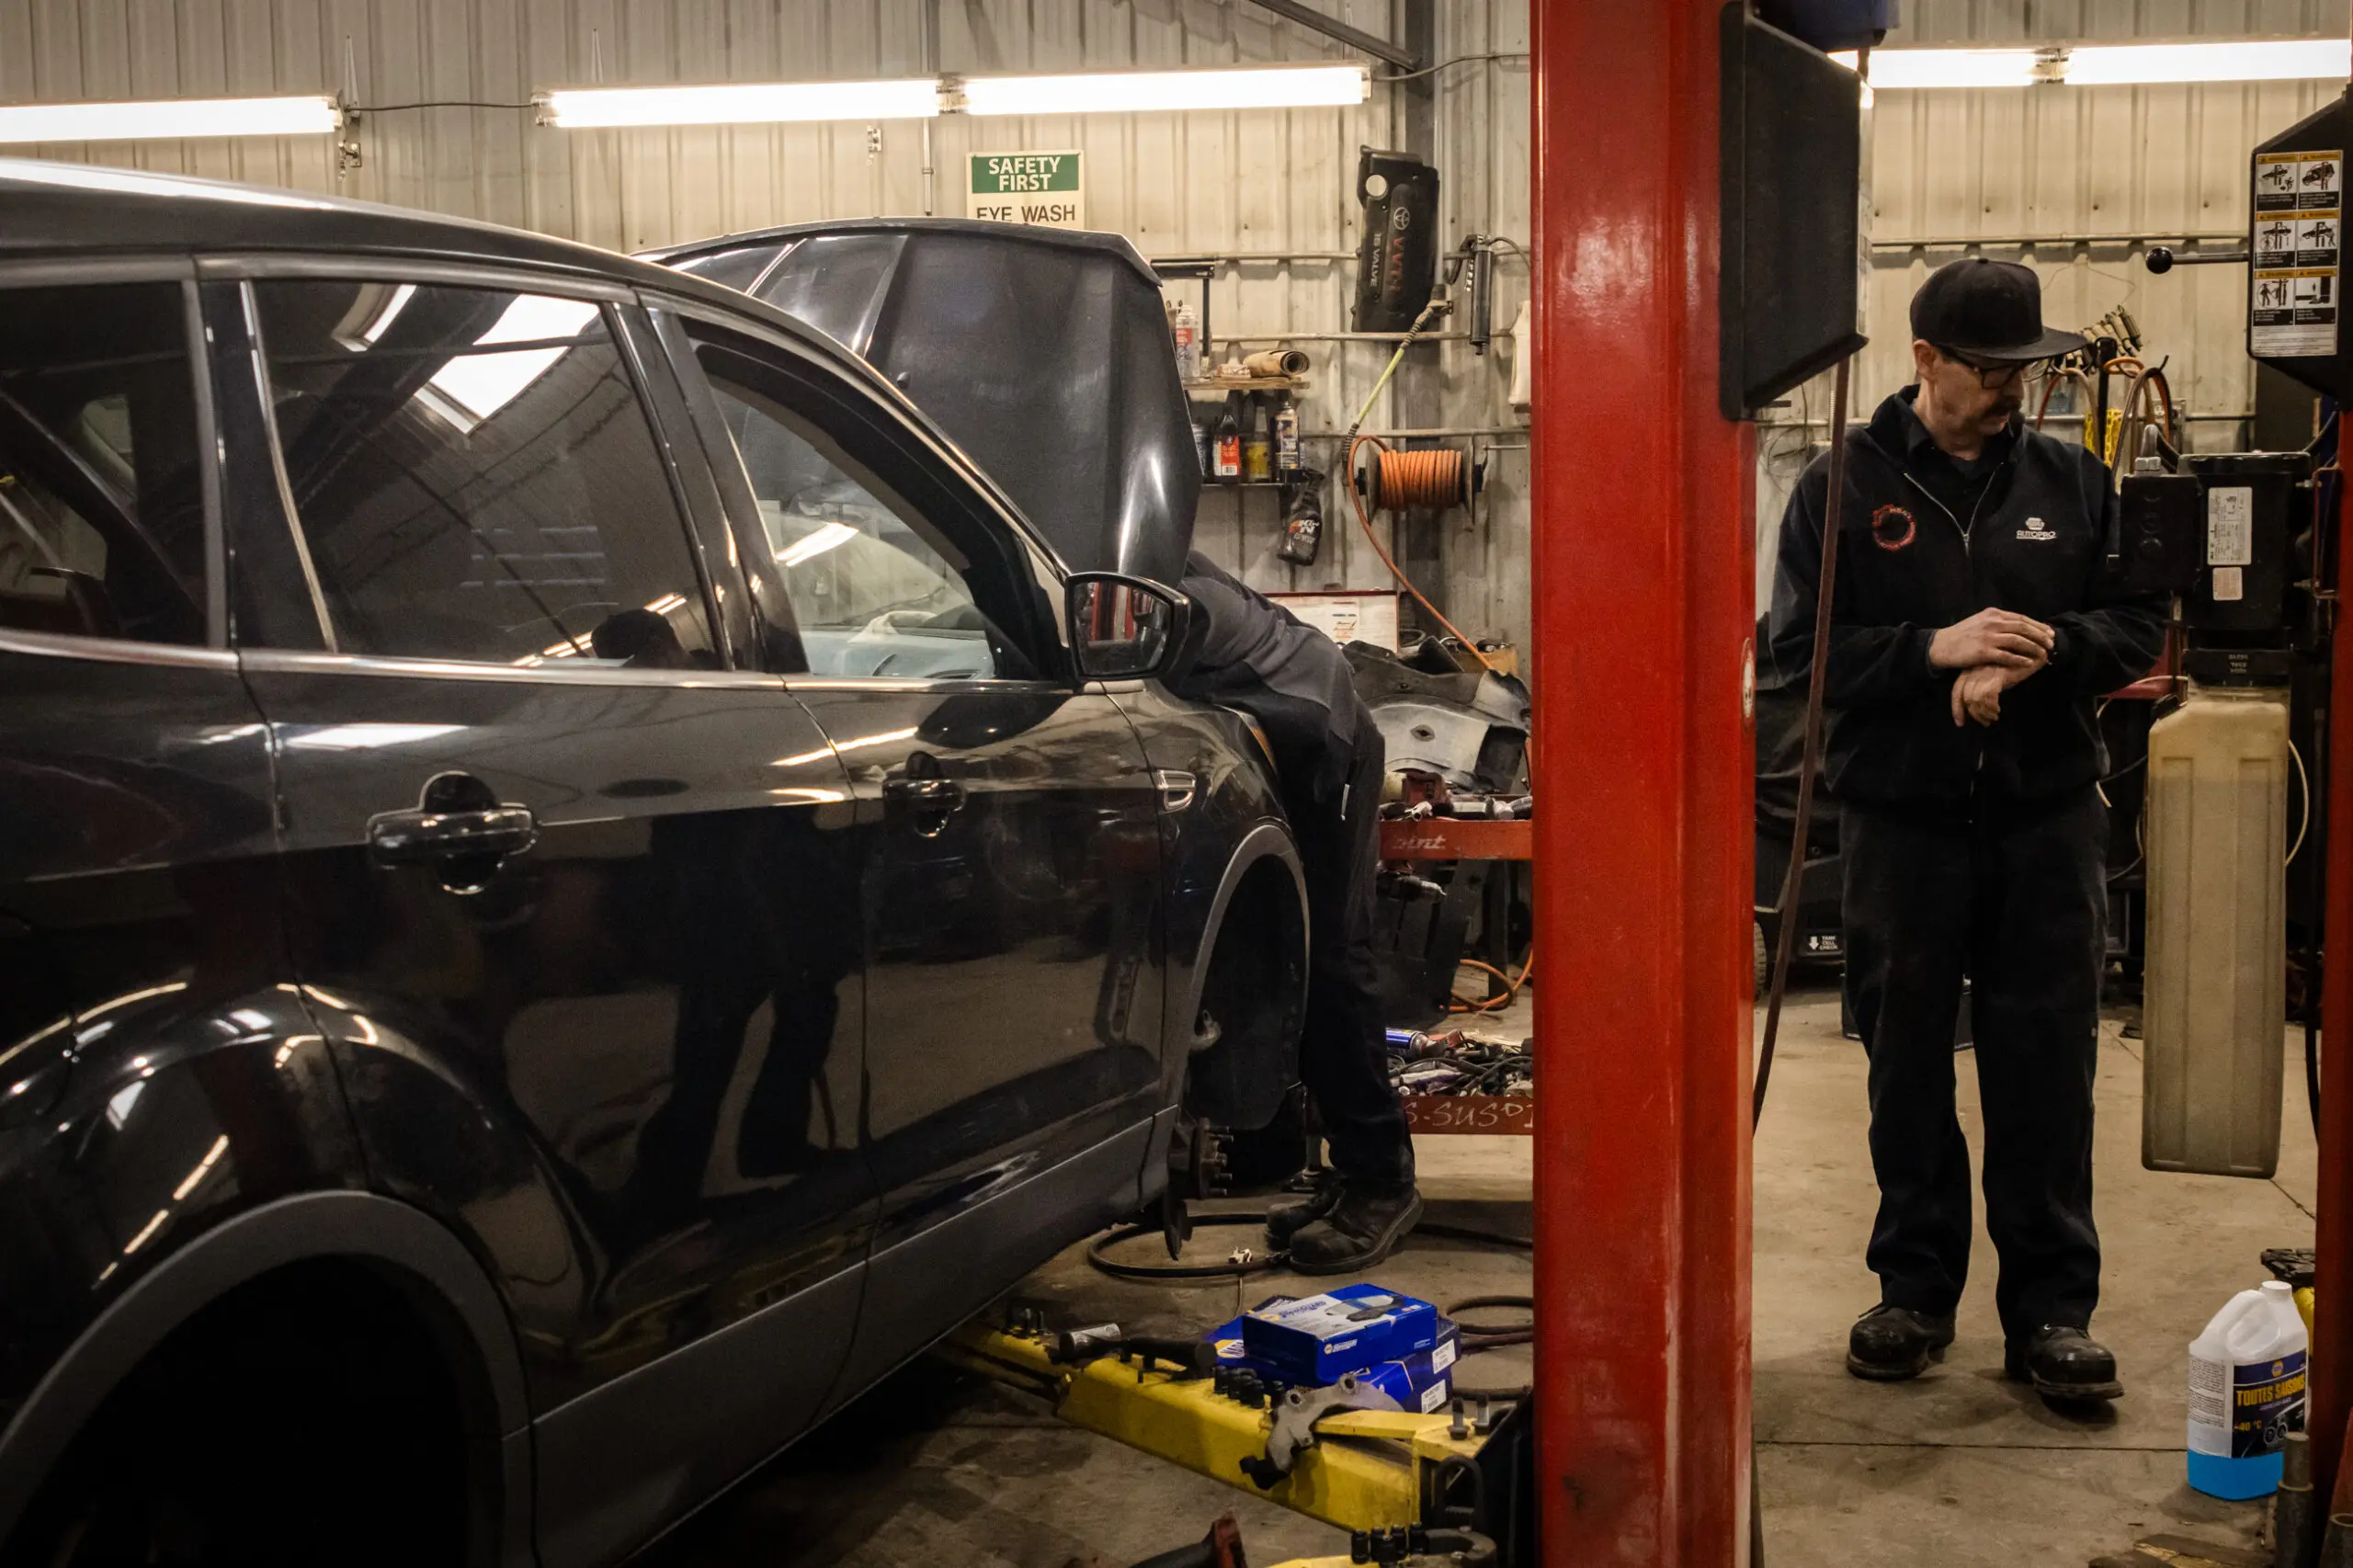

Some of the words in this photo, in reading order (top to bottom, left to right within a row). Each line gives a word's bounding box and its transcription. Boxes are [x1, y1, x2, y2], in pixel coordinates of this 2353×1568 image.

[988, 156, 1062, 175] SAFETY
[998, 174, 1051, 191] FIRST
[976, 206, 1013, 222] EYE
[1021, 204, 1075, 222] WASH
[1370, 248, 1381, 287] VALVE
[2235, 1385, 2273, 1406] TOUTES
